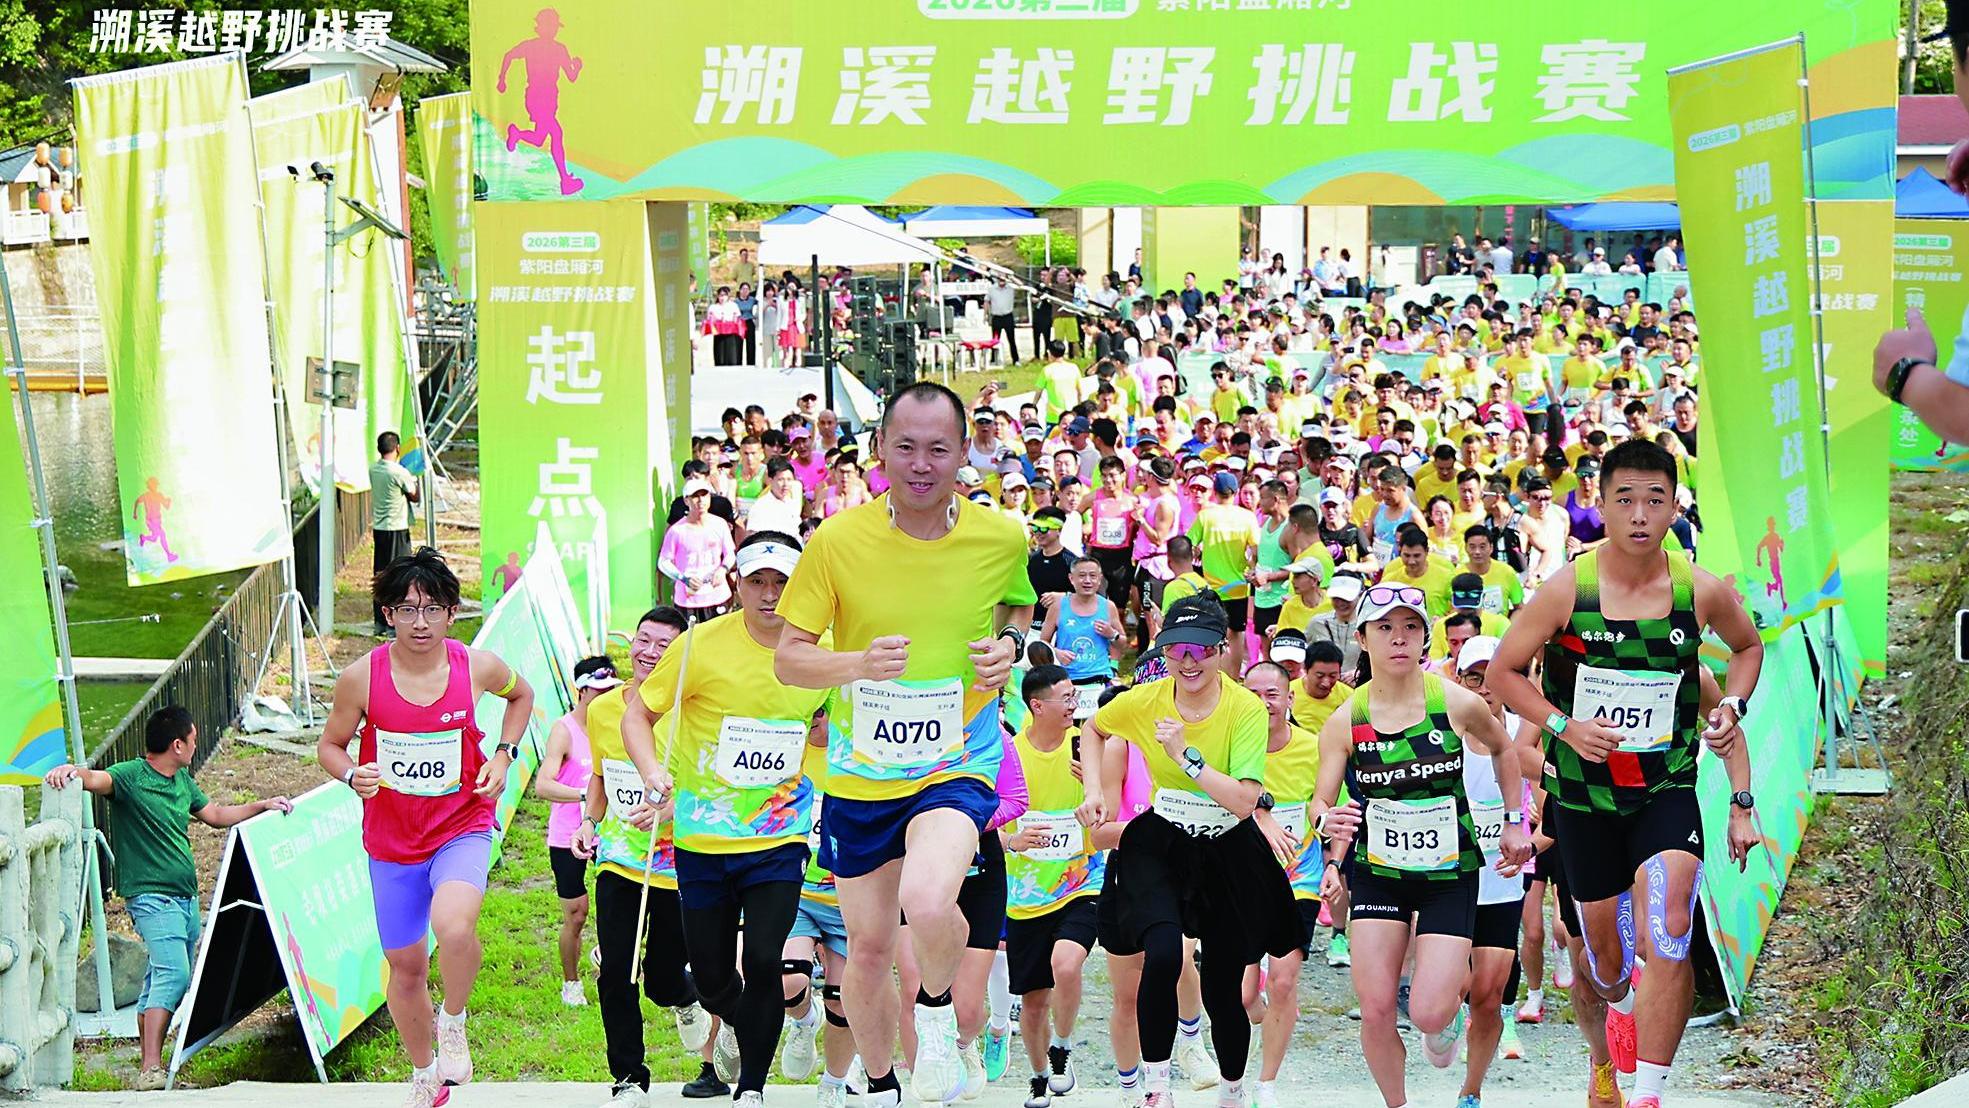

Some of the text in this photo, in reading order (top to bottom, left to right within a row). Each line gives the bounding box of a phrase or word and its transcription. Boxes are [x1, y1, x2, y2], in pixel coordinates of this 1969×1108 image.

[694, 38, 1648, 126] 溯溪越野挑战赛
[489, 285, 637, 303] 溯溪越野挑战赛
[1734, 161, 1808, 533] 溯溪越野挑战赛
[525, 325, 604, 517] 起点
[1593, 705, 1653, 728] A051
[873, 719, 942, 744] A070
[391, 761, 445, 779] C408
[733, 750, 786, 770] A066
[1355, 756, 1461, 785] Kenya Speed
[1385, 828, 1439, 851] B133
